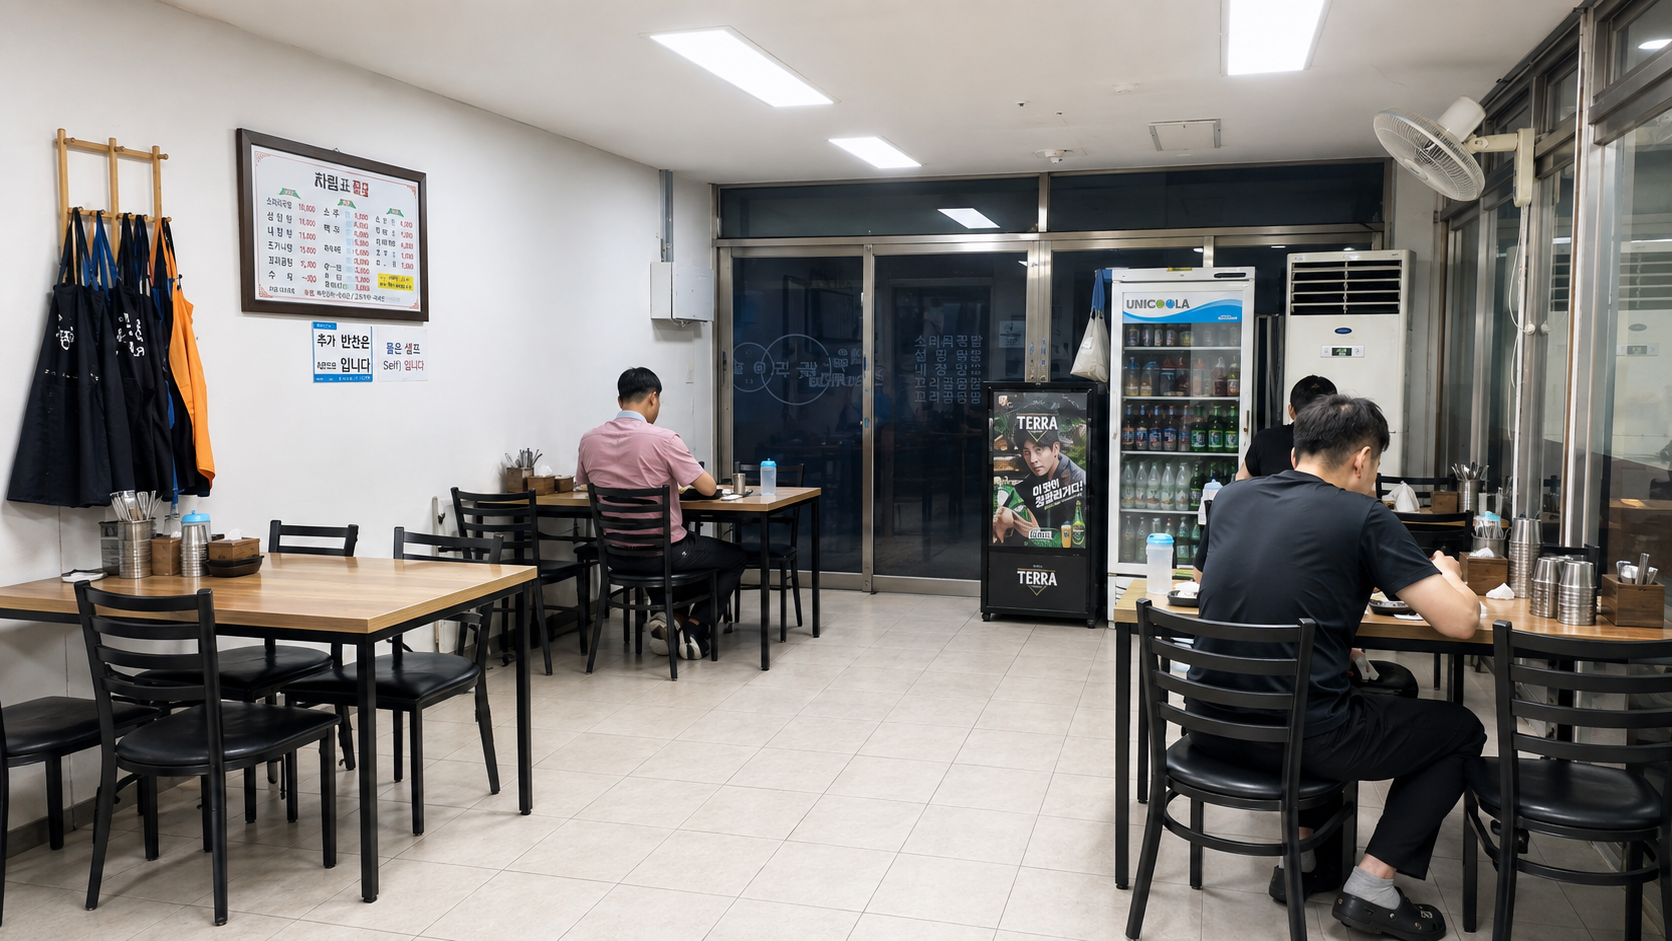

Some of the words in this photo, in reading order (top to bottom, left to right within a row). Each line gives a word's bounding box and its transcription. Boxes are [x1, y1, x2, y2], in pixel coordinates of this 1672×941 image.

[314, 172, 351, 193] 차림표
[1126, 299, 1190, 309] UNICOOLA
[316, 333, 336, 348] 추가
[340, 334, 370, 350] 반찬은
[340, 357, 371, 373] 입니다
[1016, 416, 1058, 430] TERRA
[1017, 570, 1058, 586] TERRA
